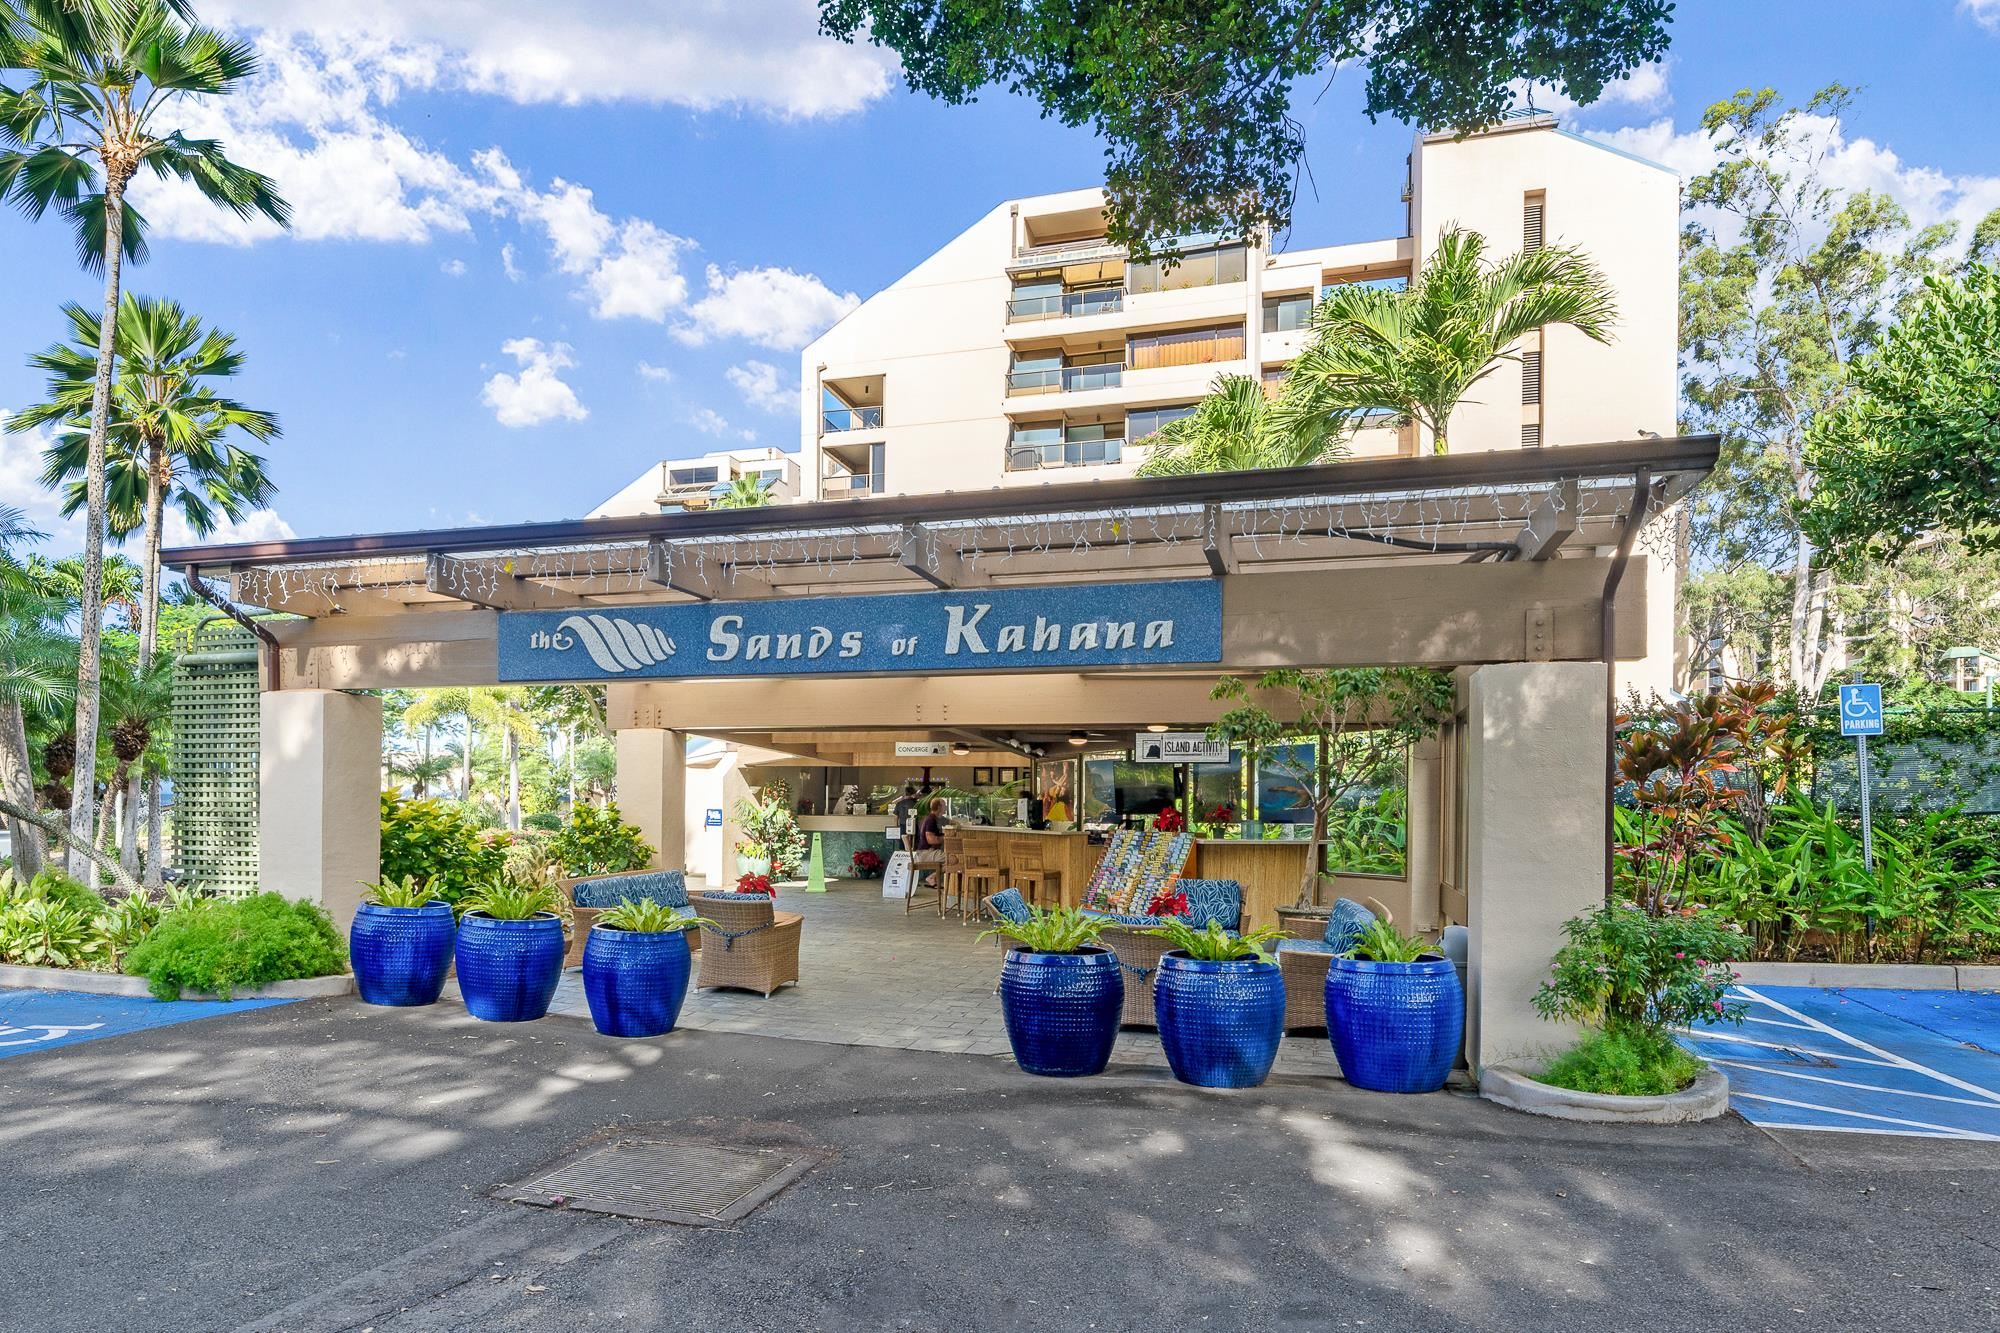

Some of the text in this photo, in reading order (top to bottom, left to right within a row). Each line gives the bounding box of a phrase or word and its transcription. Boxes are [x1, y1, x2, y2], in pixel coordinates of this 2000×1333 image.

[529, 603, 1175, 662] the Sands of Kahana
[1844, 718, 1880, 730] PARKING
[1164, 741, 1191, 753] ISLAND
